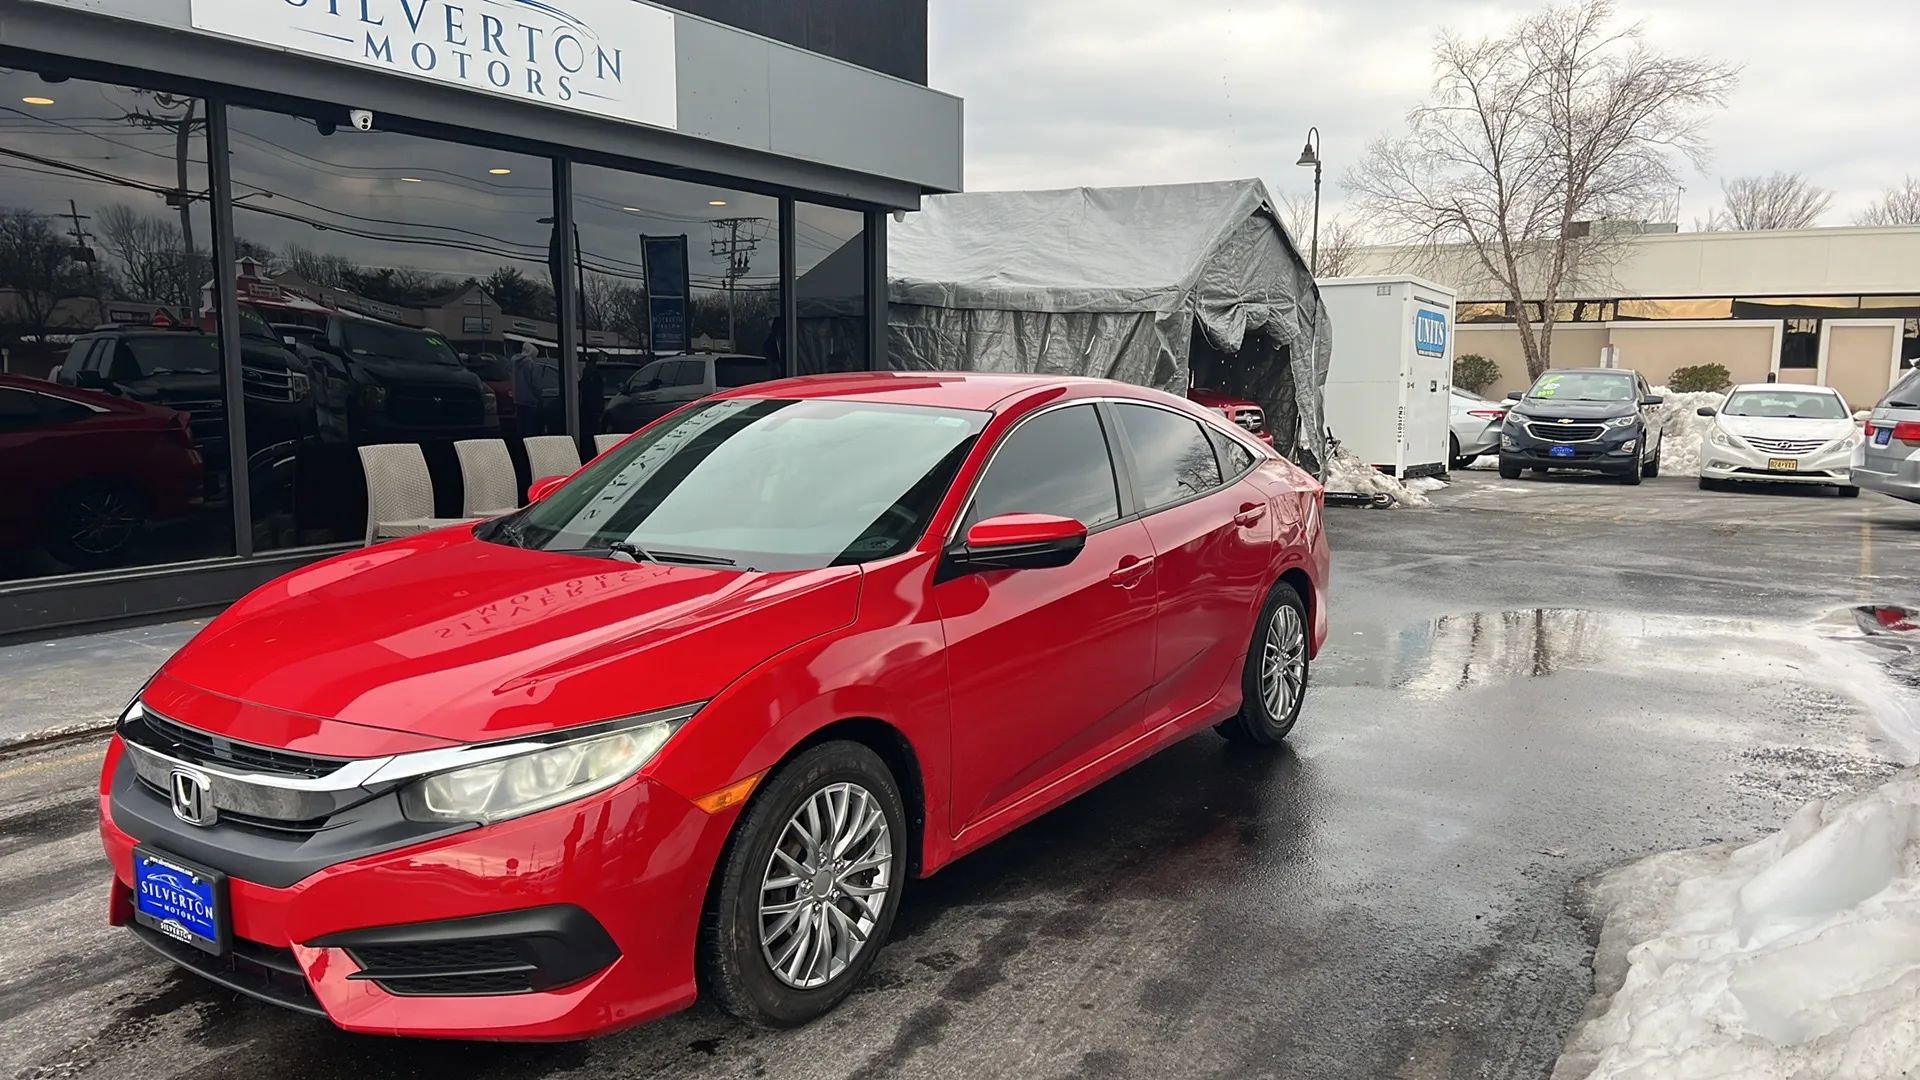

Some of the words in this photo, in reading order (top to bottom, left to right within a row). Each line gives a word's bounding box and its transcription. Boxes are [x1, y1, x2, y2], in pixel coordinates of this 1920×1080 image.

[284, 0, 622, 84] LVERTON
[364, 30, 573, 102] MOTORS
[1418, 316, 1444, 345] UNITS
[141, 880, 214, 920] SILVERTON
[164, 904, 196, 922] MOTORS
